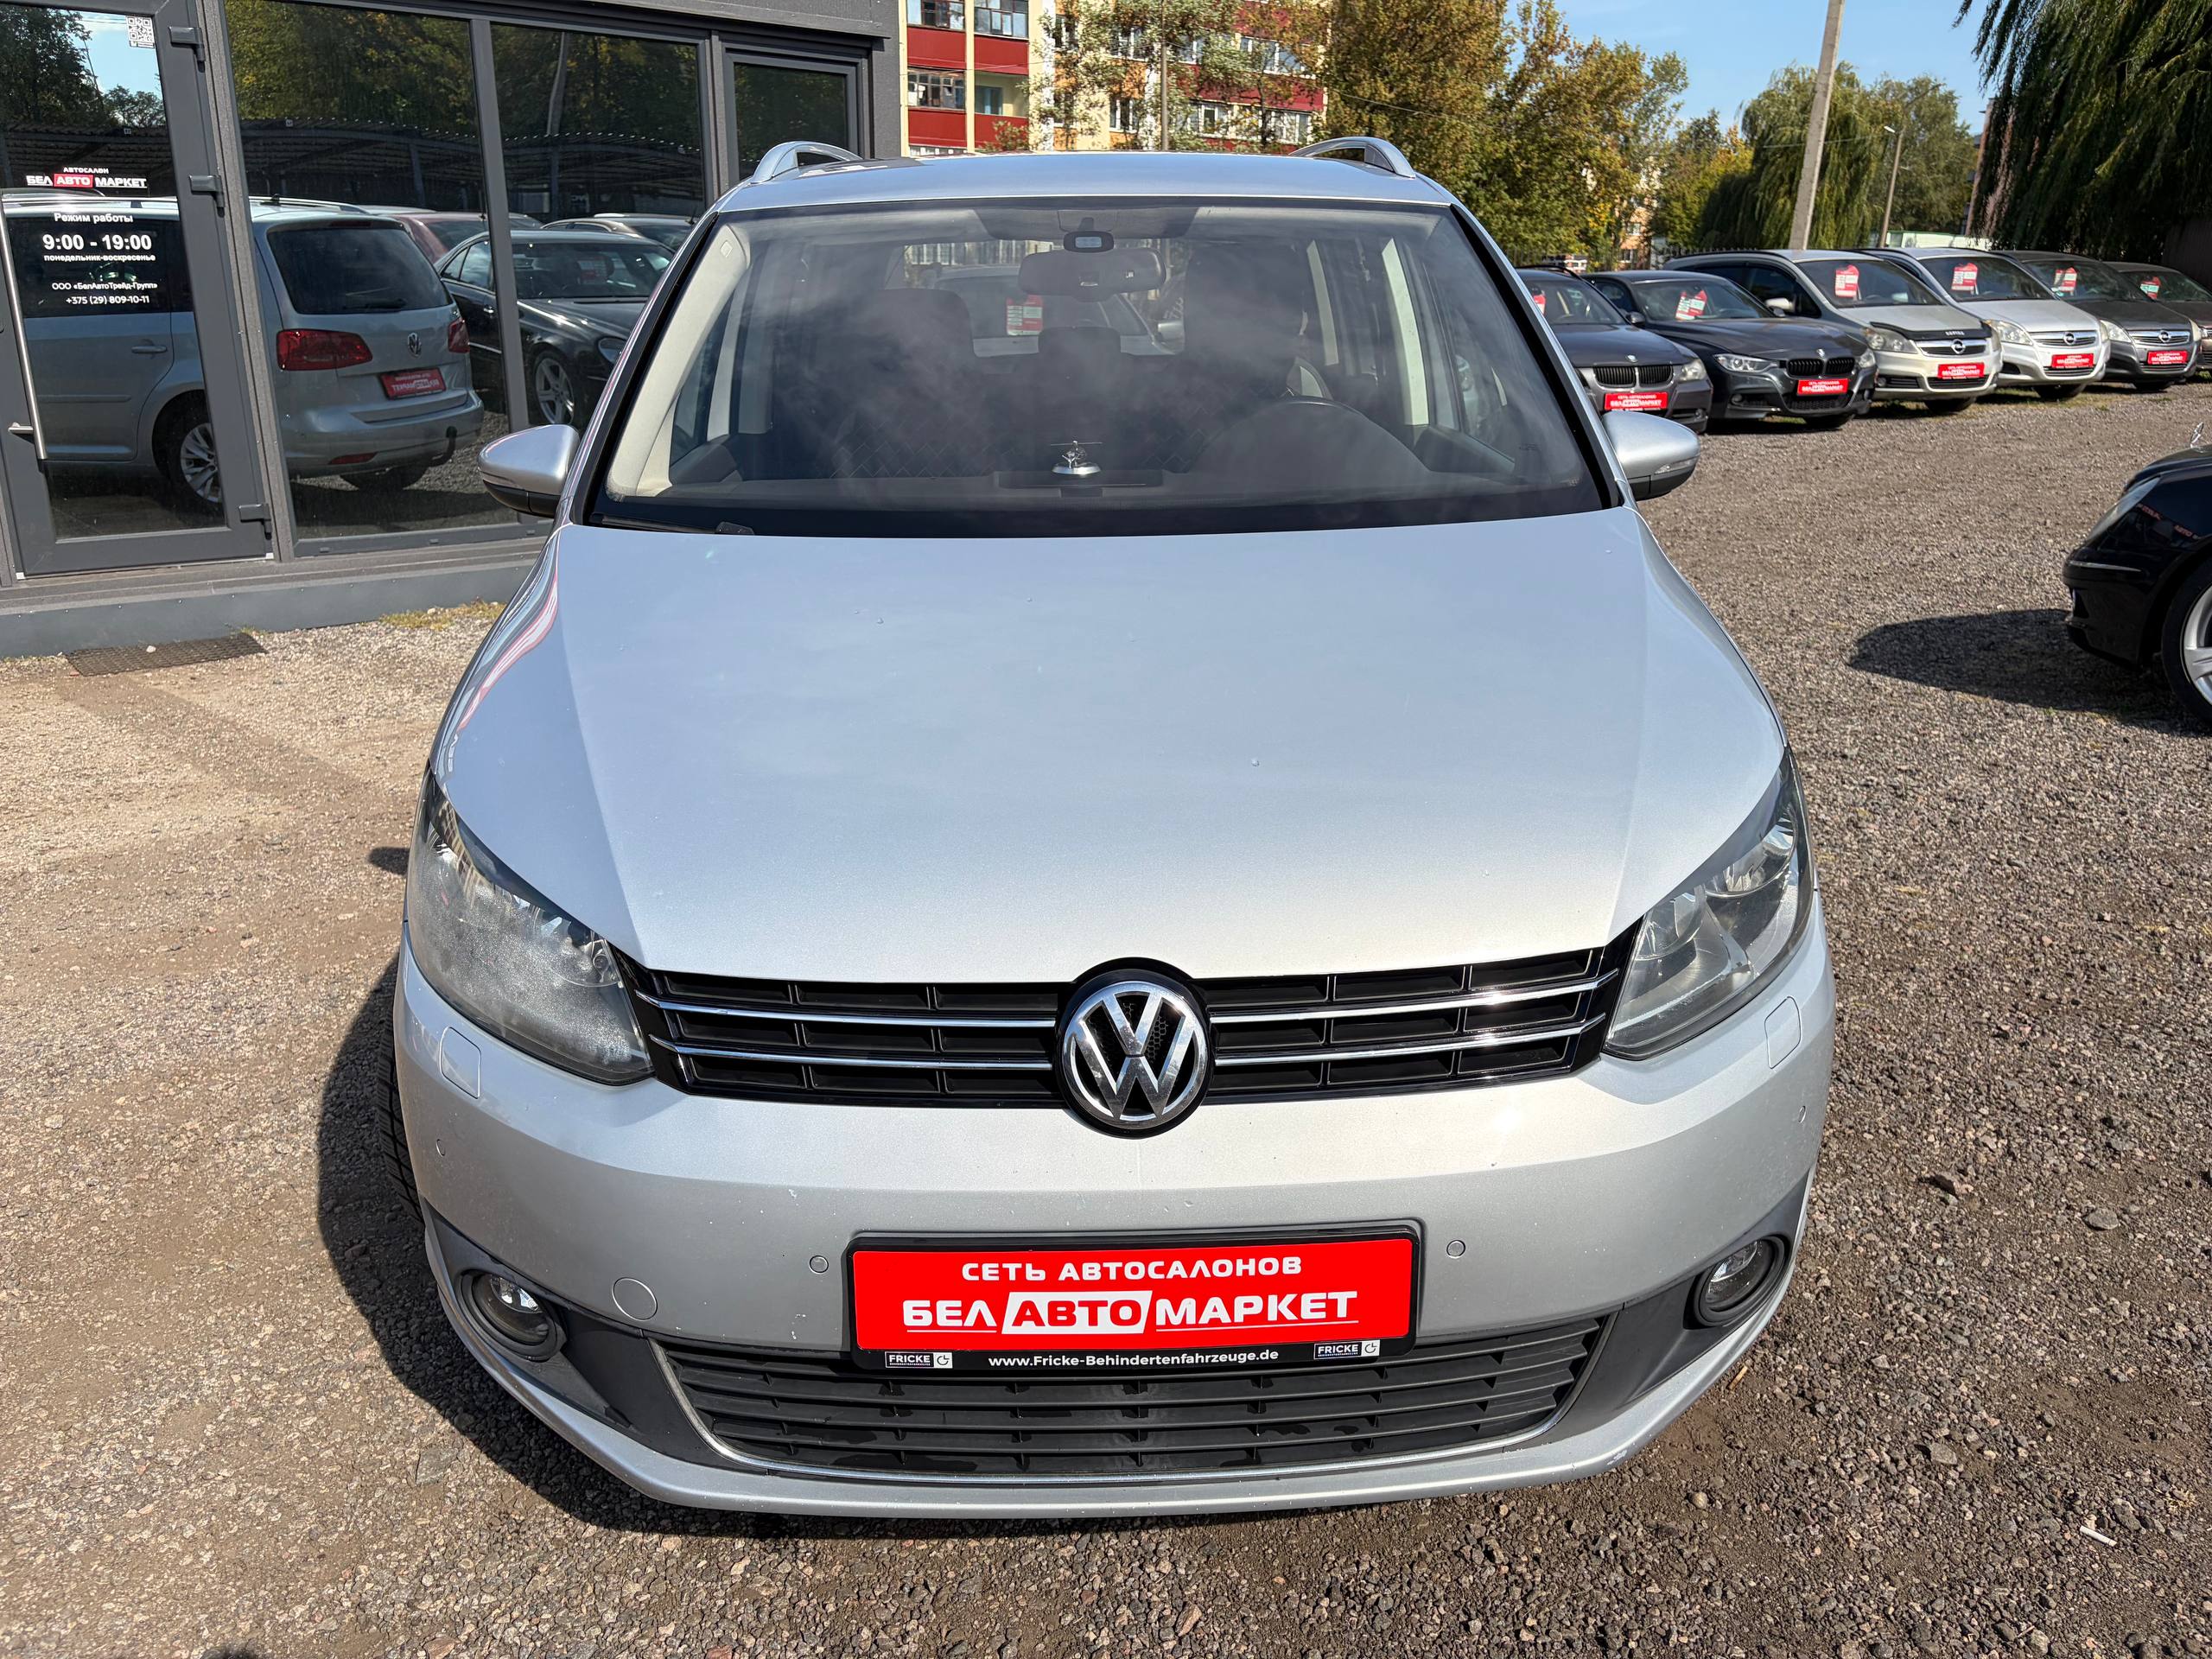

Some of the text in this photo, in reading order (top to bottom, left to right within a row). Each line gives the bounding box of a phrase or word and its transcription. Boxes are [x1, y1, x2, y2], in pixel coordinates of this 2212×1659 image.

[54, 213, 134, 224] Режим работы
[42, 234, 85, 250] 9:00
[102, 234, 152, 250] 19:00
[52, 282, 72, 290] ООО
[66, 295, 150, 305] +375 (29) 809-10-11
[962, 1256, 1302, 1281] СЕТЬ АВТОСАЛОНОВ
[1318, 1344, 1359, 1354] FRICKE
[888, 1354, 931, 1363] FRICKE
[988, 1349, 1279, 1367] www.Fricke-Behindertenfahrzeuge.de
